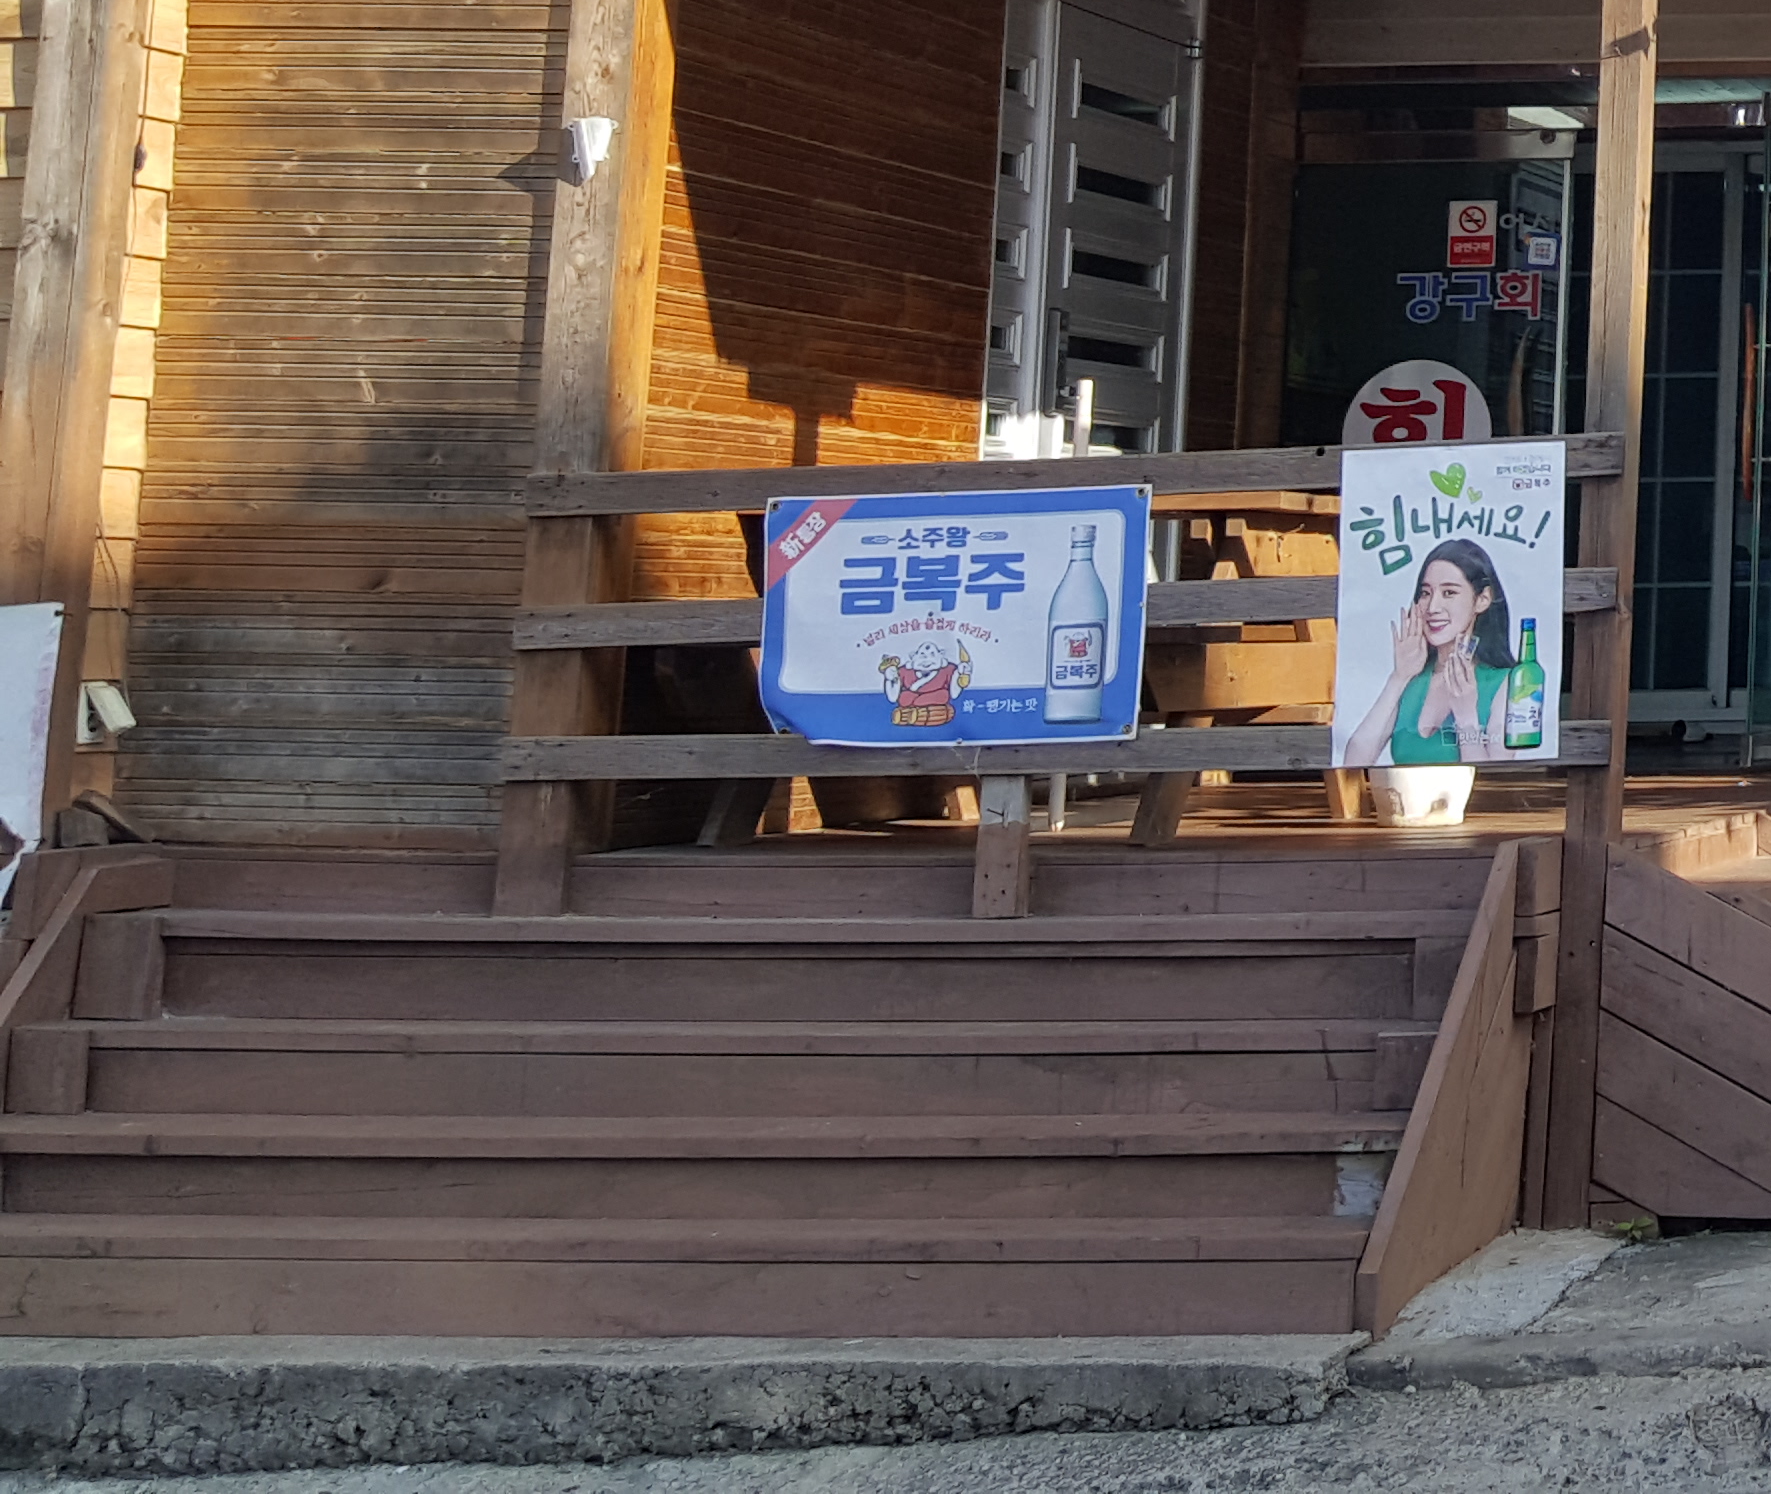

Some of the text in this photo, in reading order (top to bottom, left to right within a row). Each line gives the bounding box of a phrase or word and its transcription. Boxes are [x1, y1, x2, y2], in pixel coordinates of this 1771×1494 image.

[1396, 269, 1543, 324] 강구회
[897, 526, 971, 550] 소주왕
[1350, 494, 1551, 576] 힘내세요!
[839, 552, 1026, 616] 금복주
[1054, 663, 1099, 680] 금복주
[1025, 697, 1038, 712] 맛
